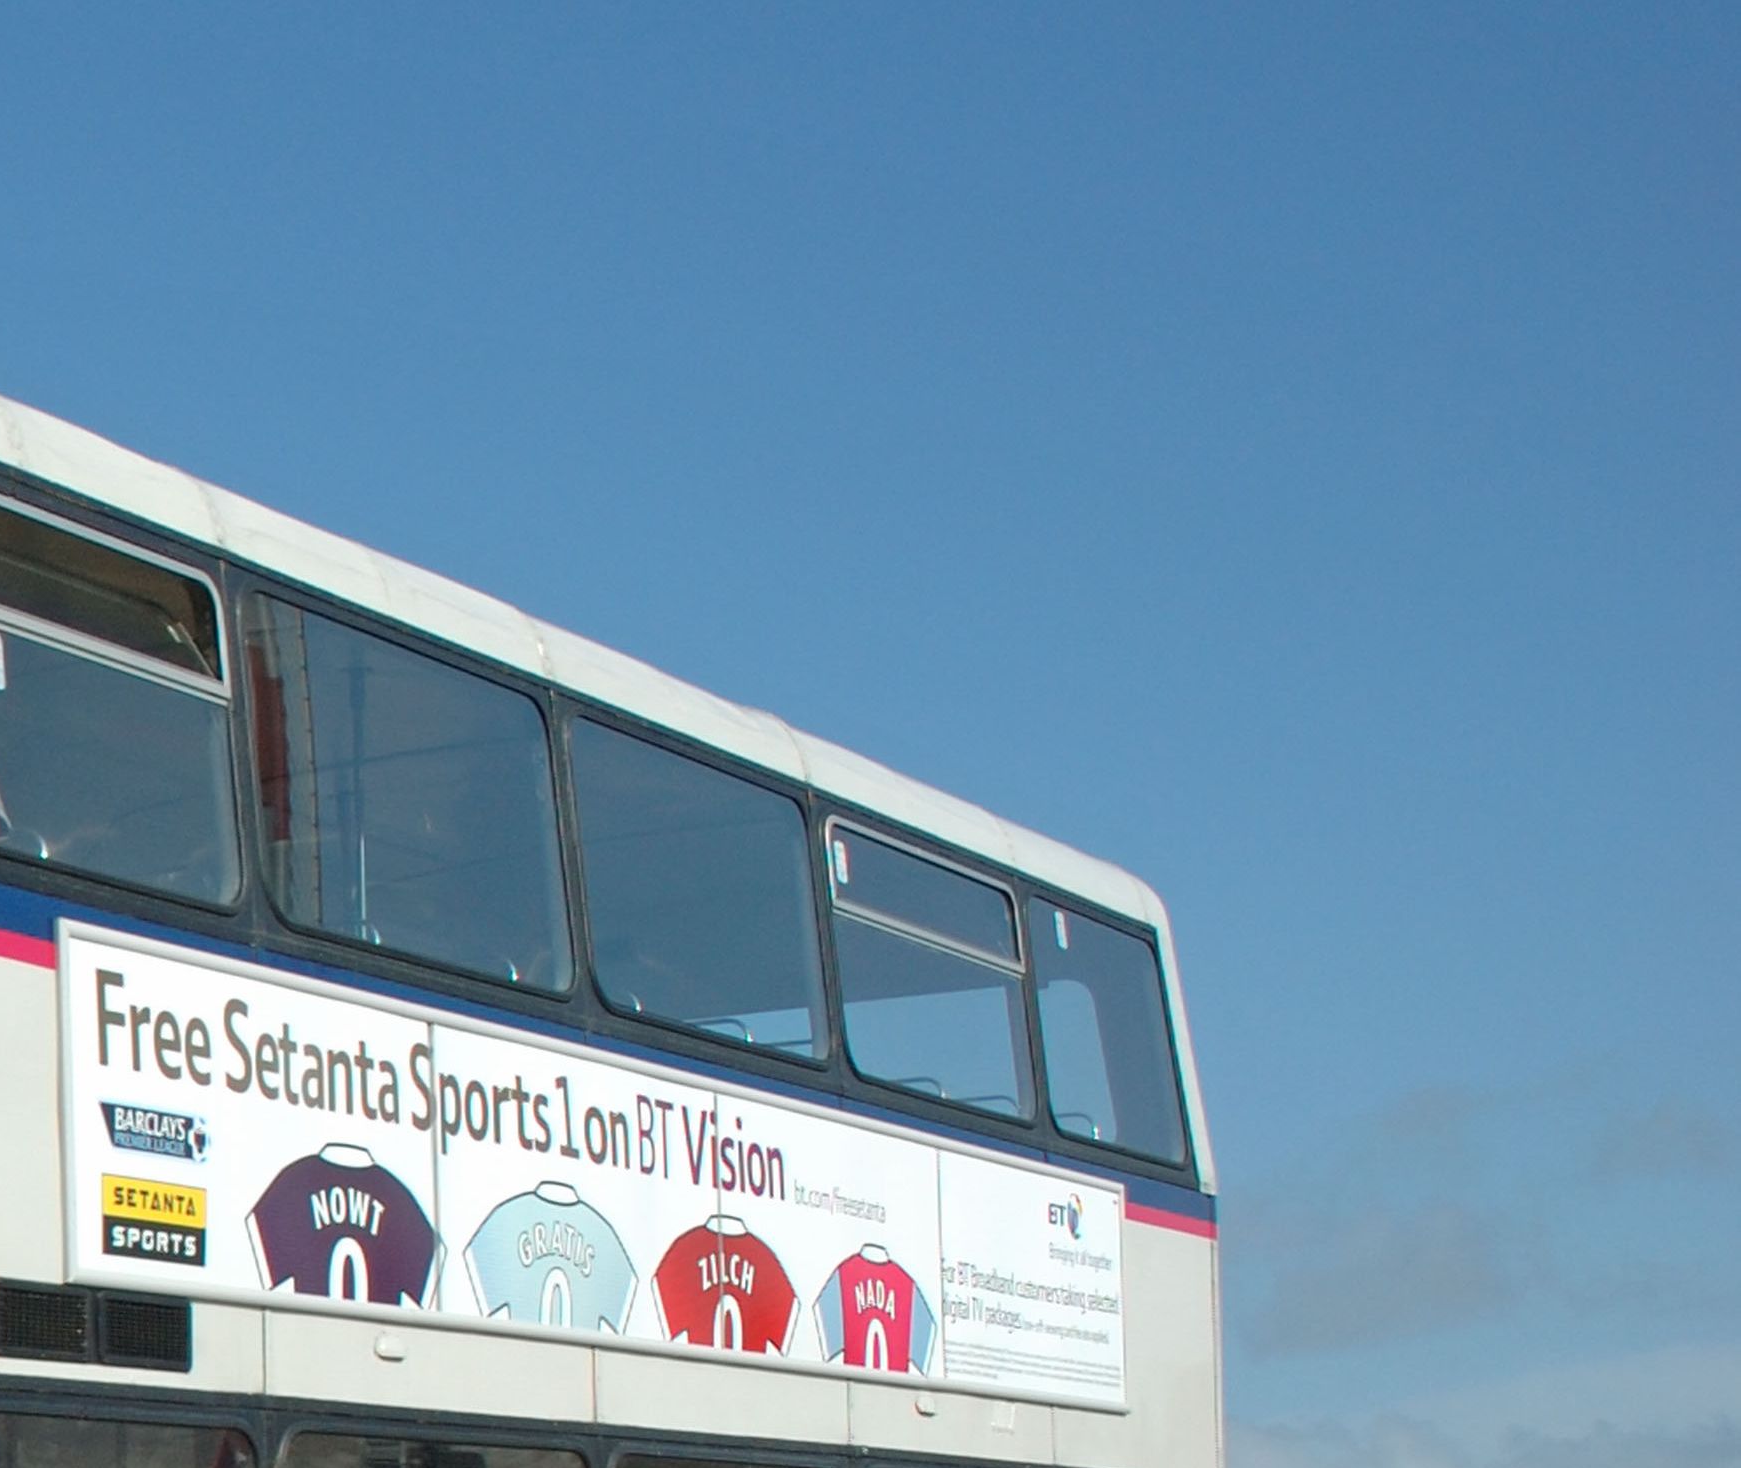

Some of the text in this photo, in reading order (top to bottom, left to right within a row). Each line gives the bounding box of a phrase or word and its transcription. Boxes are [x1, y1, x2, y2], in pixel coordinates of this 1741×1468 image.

[96, 969, 786, 1201] Free Setanta Sports 1 on BT Vision
[113, 1106, 187, 1142] BARCLAYS
[113, 1185, 197, 1217] SETANTA
[310, 1185, 386, 1238] NOWT
[1048, 1202, 1066, 1227] BT
[111, 1225, 198, 1258] SPORTS
[518, 1220, 597, 1278] GRATIS
[697, 1251, 757, 1296] ZILCH
[855, 1280, 897, 1322] NADA
